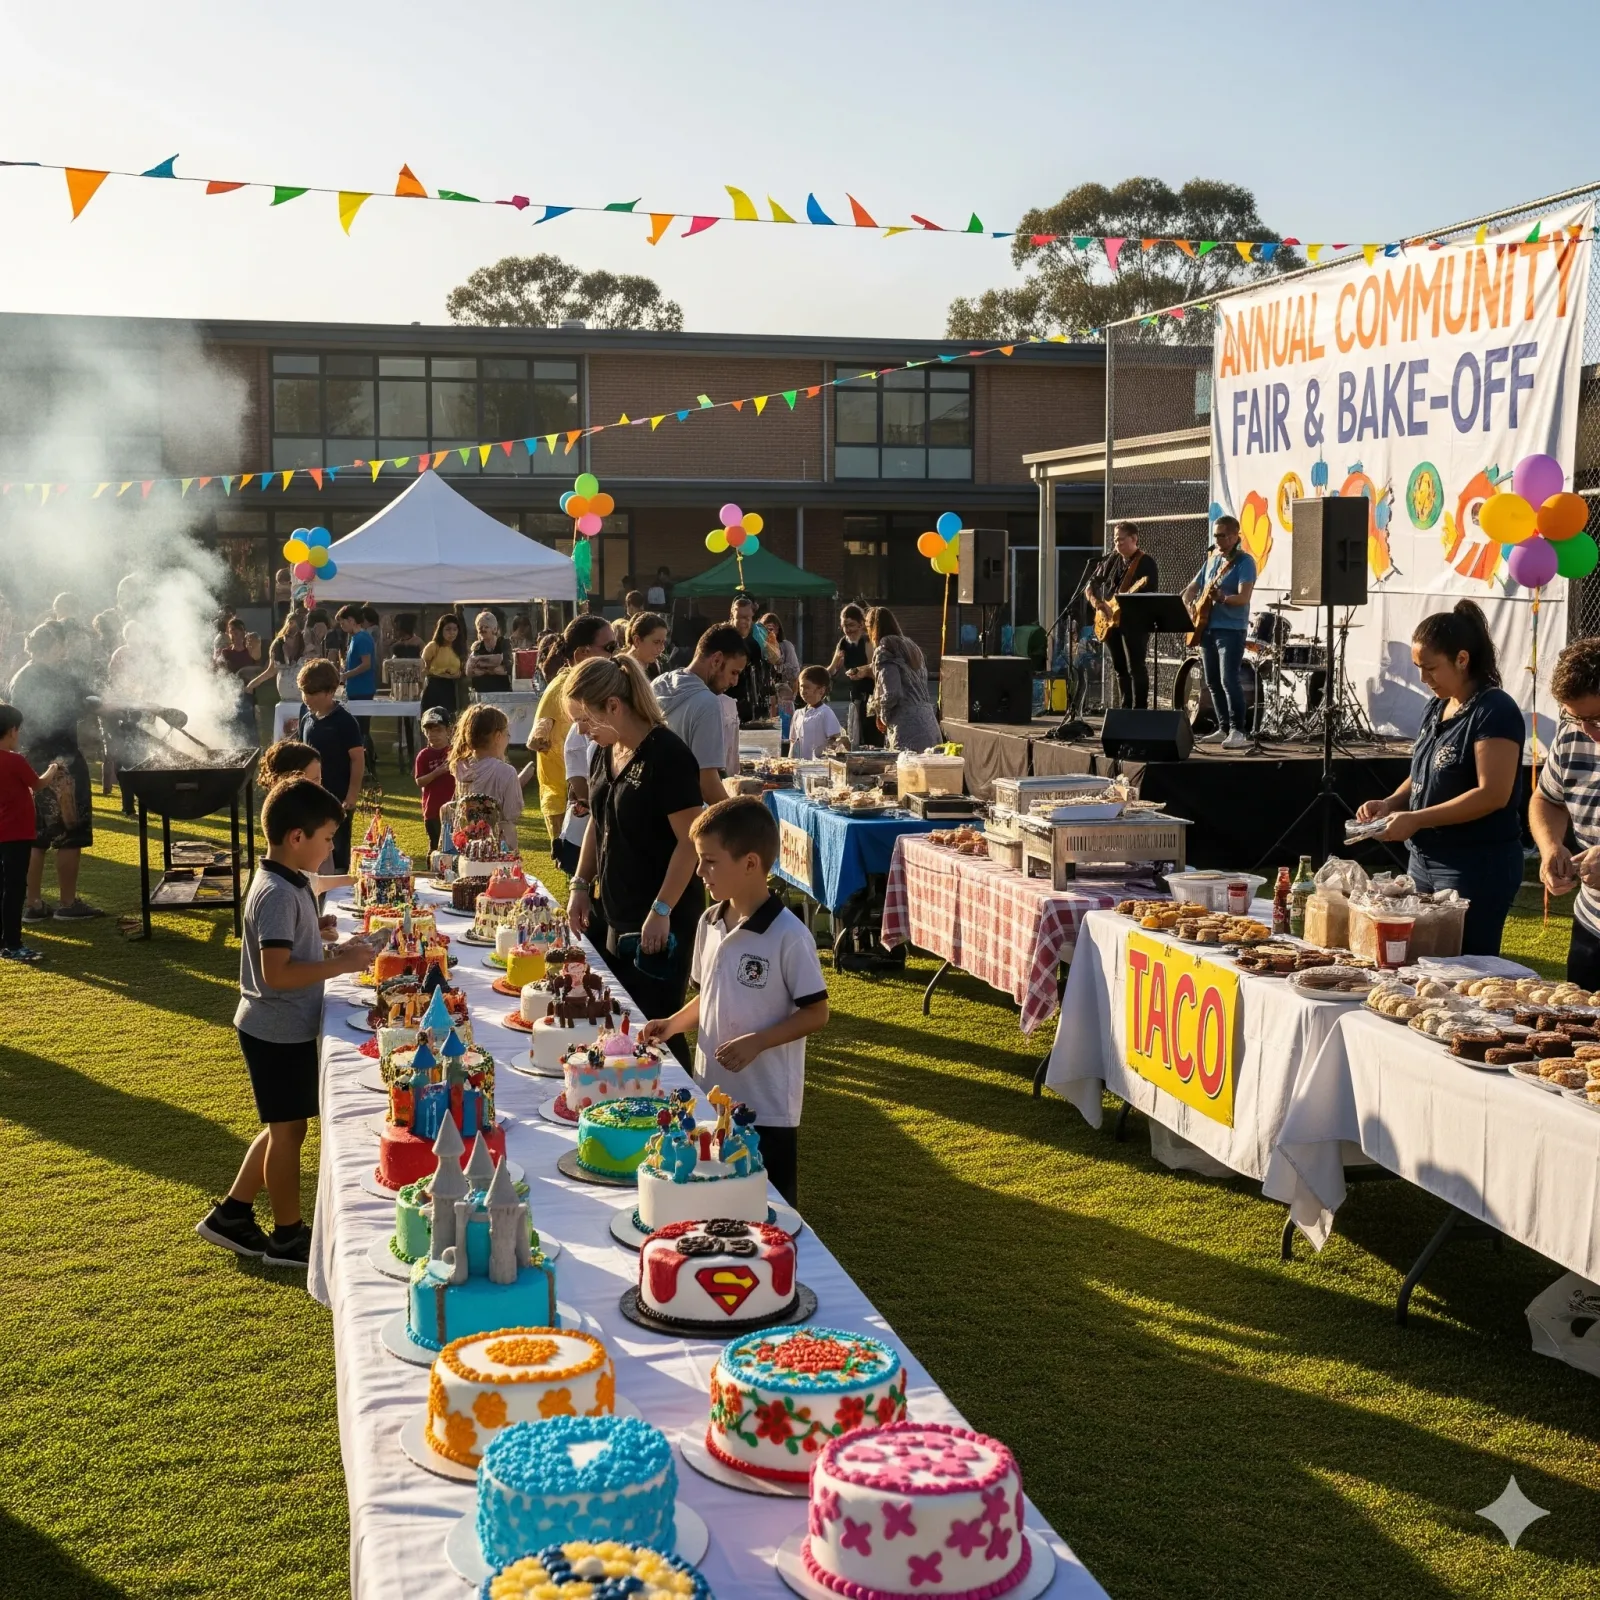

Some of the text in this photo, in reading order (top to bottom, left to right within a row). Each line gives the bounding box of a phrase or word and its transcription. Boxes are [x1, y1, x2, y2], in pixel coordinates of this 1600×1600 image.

[1220, 229, 1582, 378] ANNUAL COMMUNITY
[1232, 341, 1538, 456] FAIR & BAKE-OFF
[1129, 949, 1226, 1098] TACO
